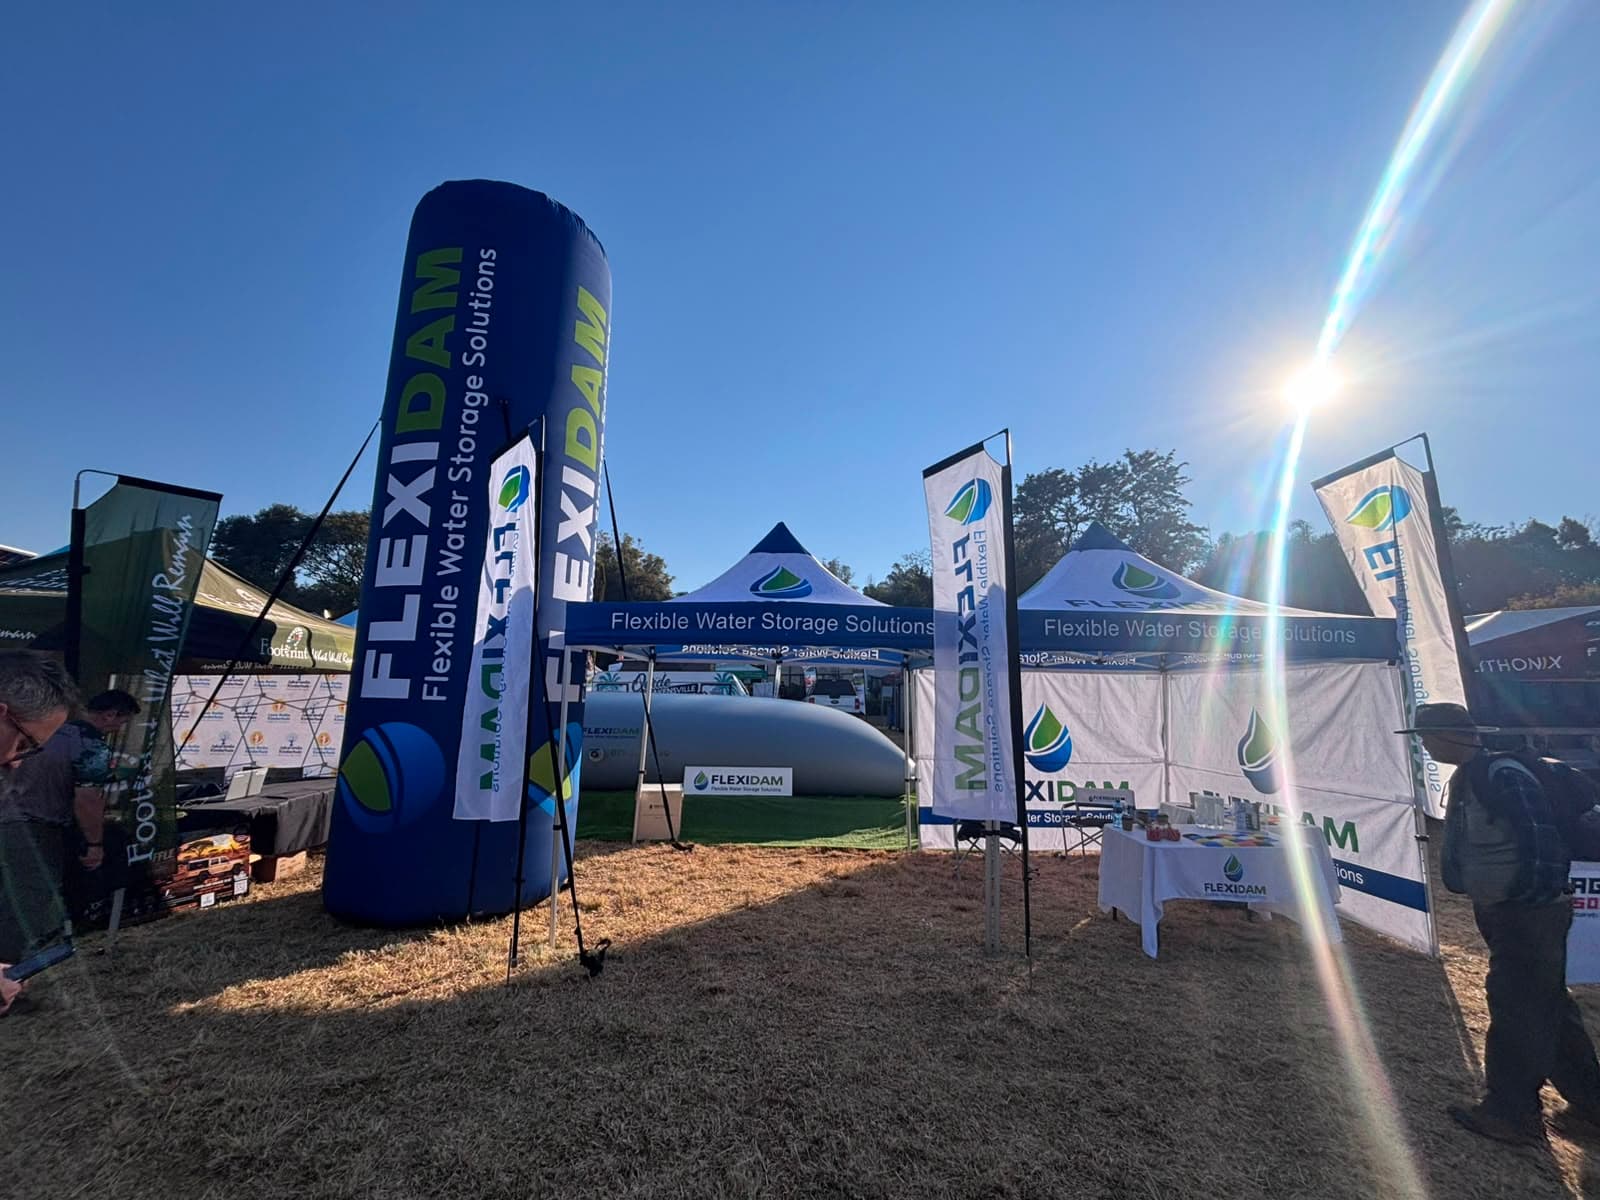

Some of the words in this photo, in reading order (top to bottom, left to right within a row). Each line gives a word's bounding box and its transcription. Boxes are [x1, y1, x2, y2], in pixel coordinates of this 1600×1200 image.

[463, 247, 497, 368] Solutions
[447, 374, 489, 483] Storage
[359, 246, 464, 700] FLEXIDAM
[543, 285, 610, 703] FEXIDAM
[152, 514, 193, 591] Remain
[436, 489, 469, 576] Water
[423, 585, 458, 701] Flexible
[611, 612, 689, 630] Flexible
[696, 613, 756, 630] Water
[761, 612, 838, 635] Storage
[845, 615, 935, 635] Solutions
[1044, 618, 1119, 637] Flexible
[1126, 619, 1182, 638] Water
[1275, 624, 1357, 644] olutions
[711, 775, 783, 785] FLEXIDAM
[1204, 883, 1266, 895] FLEXIDAM
